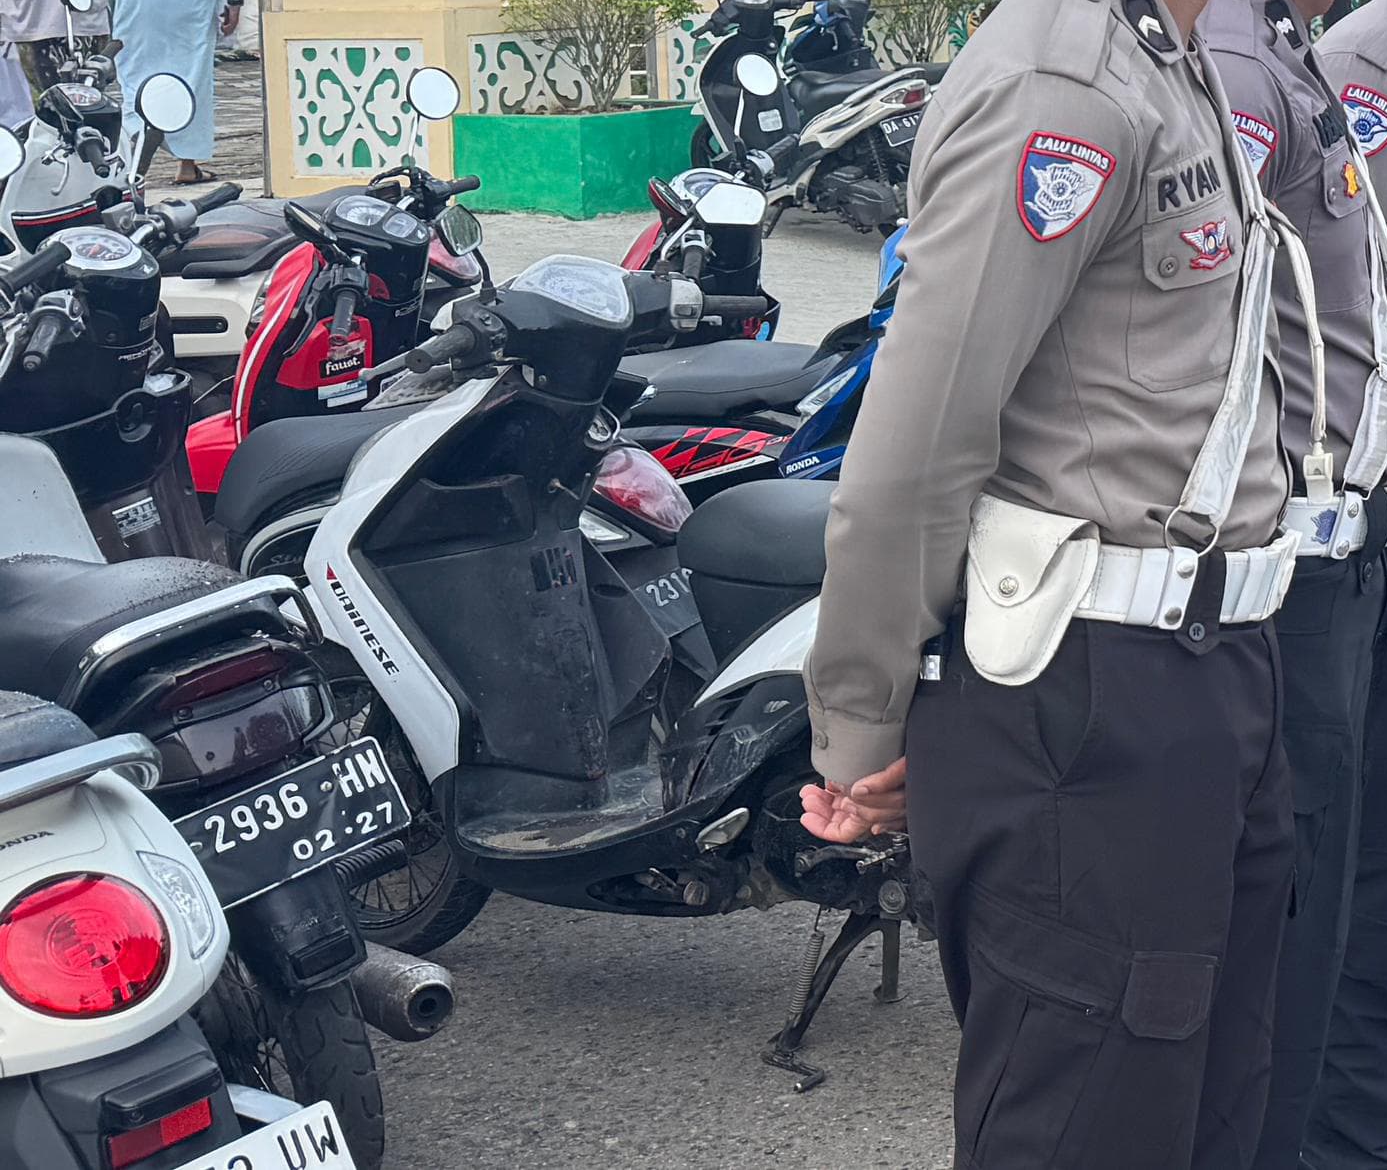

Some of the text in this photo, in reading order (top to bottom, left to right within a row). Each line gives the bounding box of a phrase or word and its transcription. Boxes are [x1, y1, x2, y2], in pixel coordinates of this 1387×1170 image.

[1347, 86, 1373, 102] LALU
[883, 120, 900, 134] DA
[1035, 136, 1109, 170] LALU LINTAS
[1157, 155, 1222, 212] RYAN
[326, 357, 361, 375] faust.
[204, 748, 387, 854] 2936 HN
[276, 1114, 340, 1170] UW
